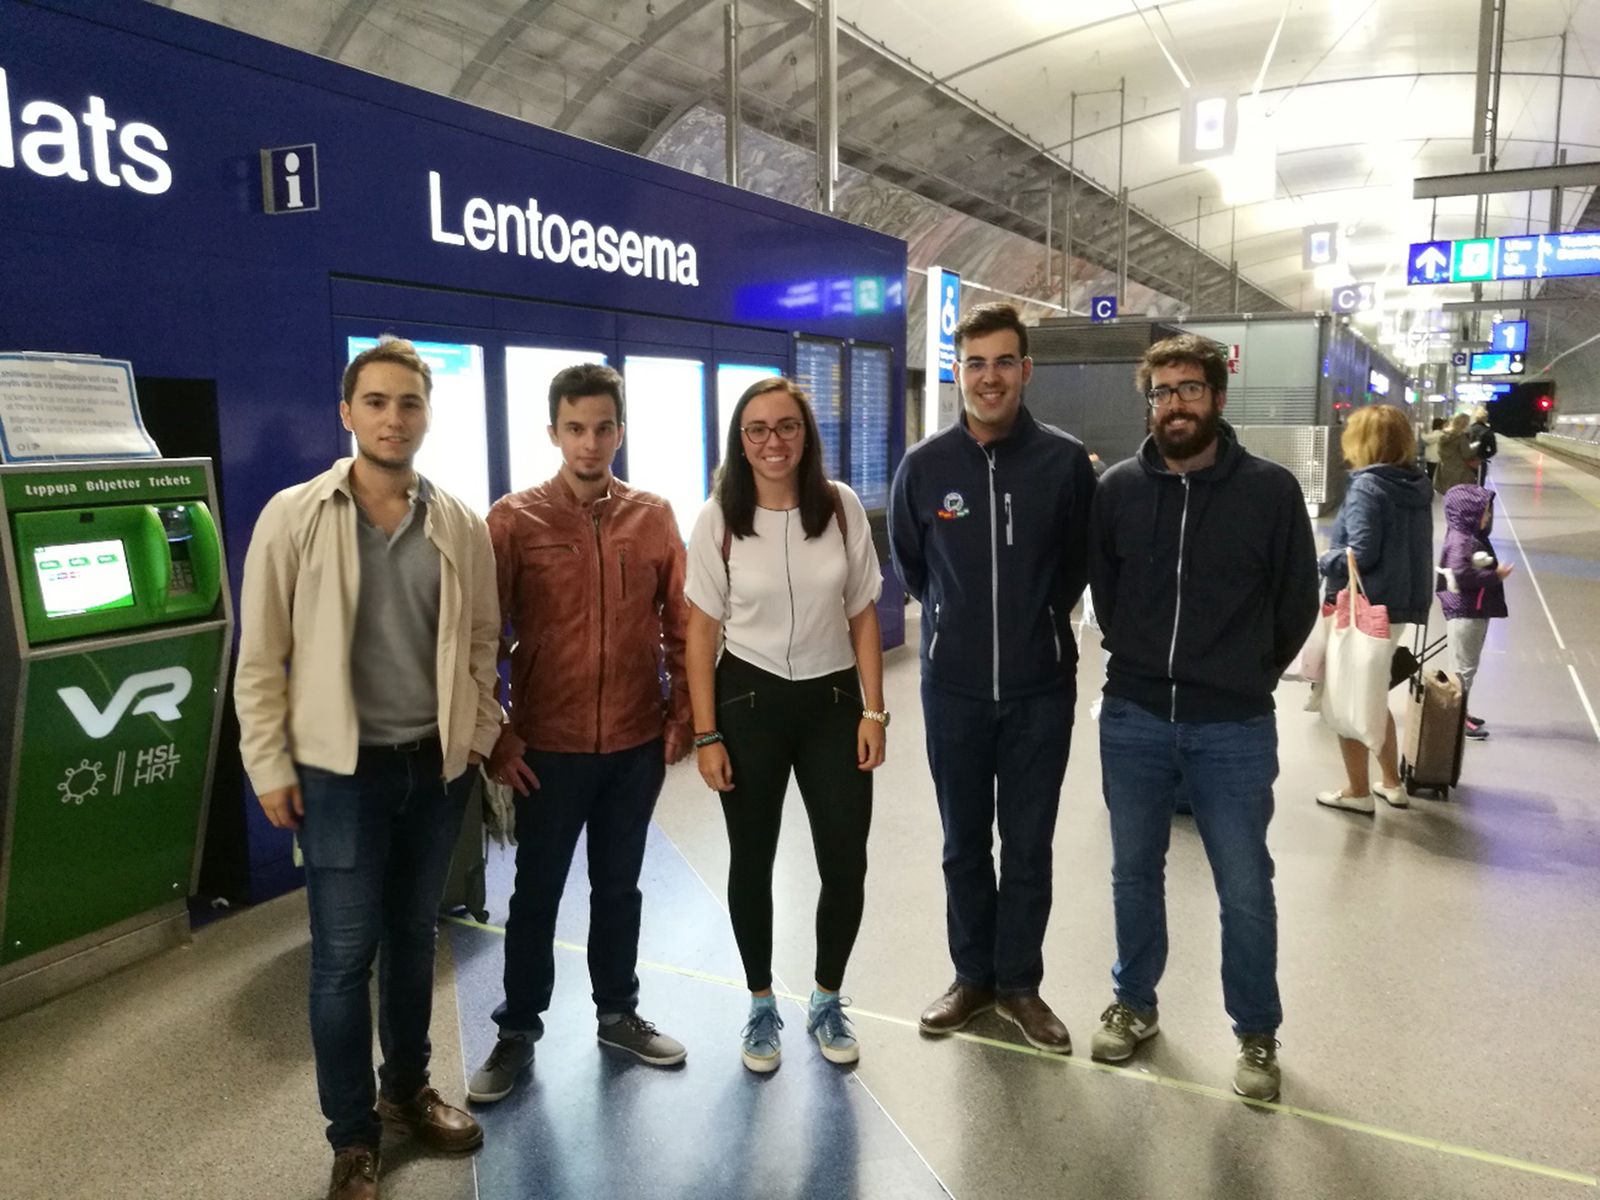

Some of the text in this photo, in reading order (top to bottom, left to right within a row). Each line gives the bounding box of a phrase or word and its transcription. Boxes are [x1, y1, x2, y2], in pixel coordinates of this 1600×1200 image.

[429, 170, 699, 286] Lentoasema
[1097, 300, 1112, 318] C
[1338, 289, 1356, 309] C
[1502, 325, 1516, 349] 1
[25, 475, 192, 497] Lippuja Biljetter Tickets
[56, 666, 193, 739] VR
[137, 743, 181, 768] HSL
[134, 759, 181, 788] HRT
